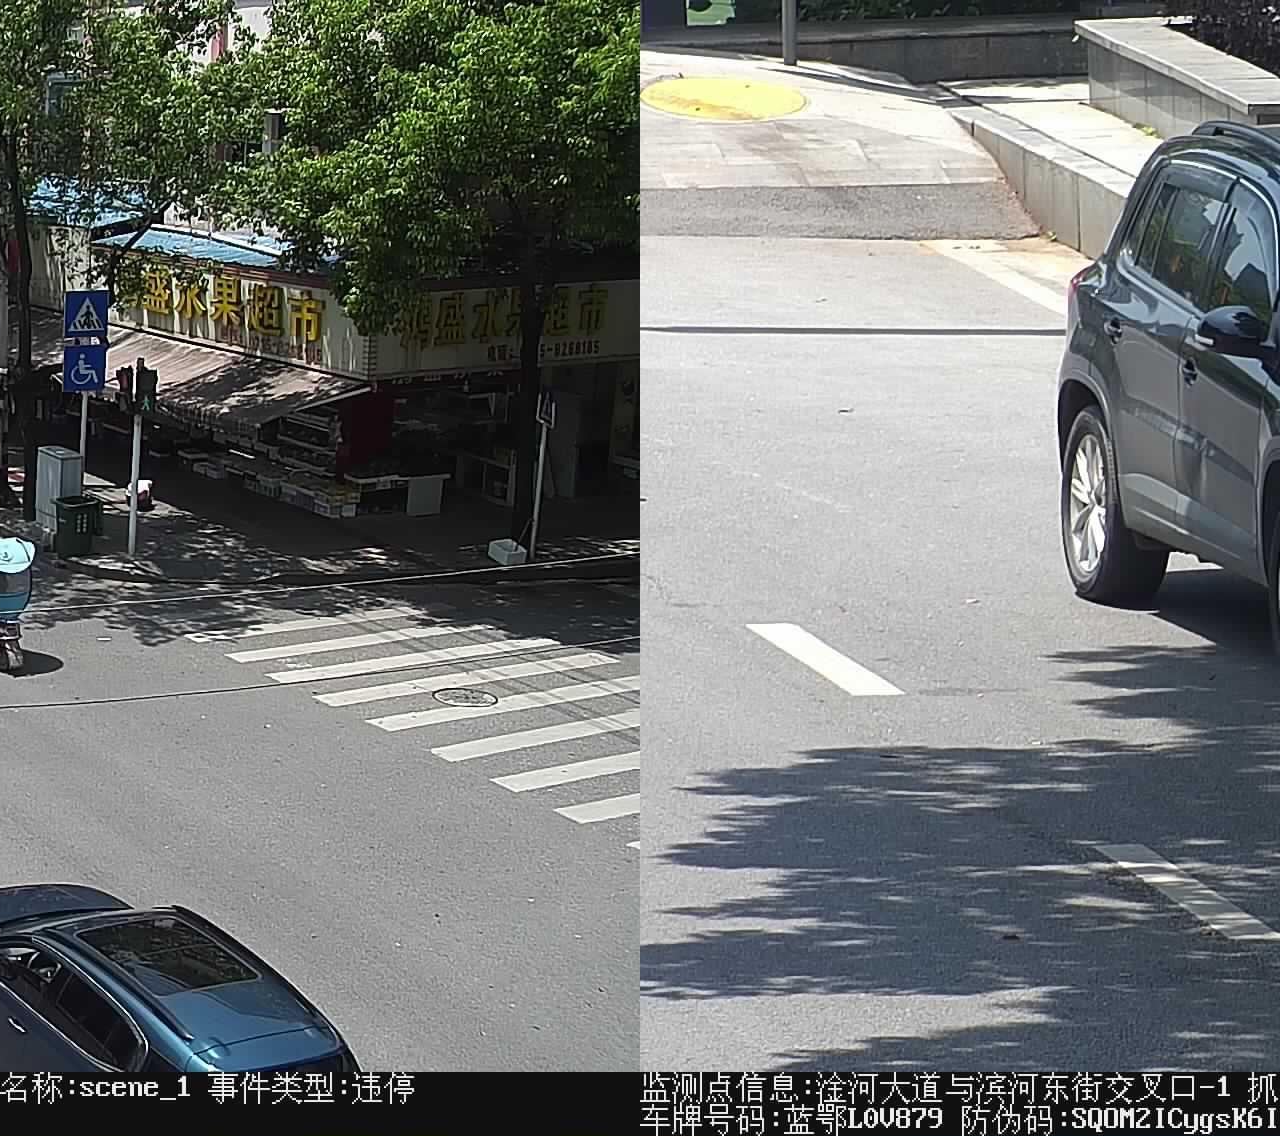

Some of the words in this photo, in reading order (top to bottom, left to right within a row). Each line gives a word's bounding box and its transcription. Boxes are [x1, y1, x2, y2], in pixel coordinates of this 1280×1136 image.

[126, 270, 324, 343] 盛水果超市
